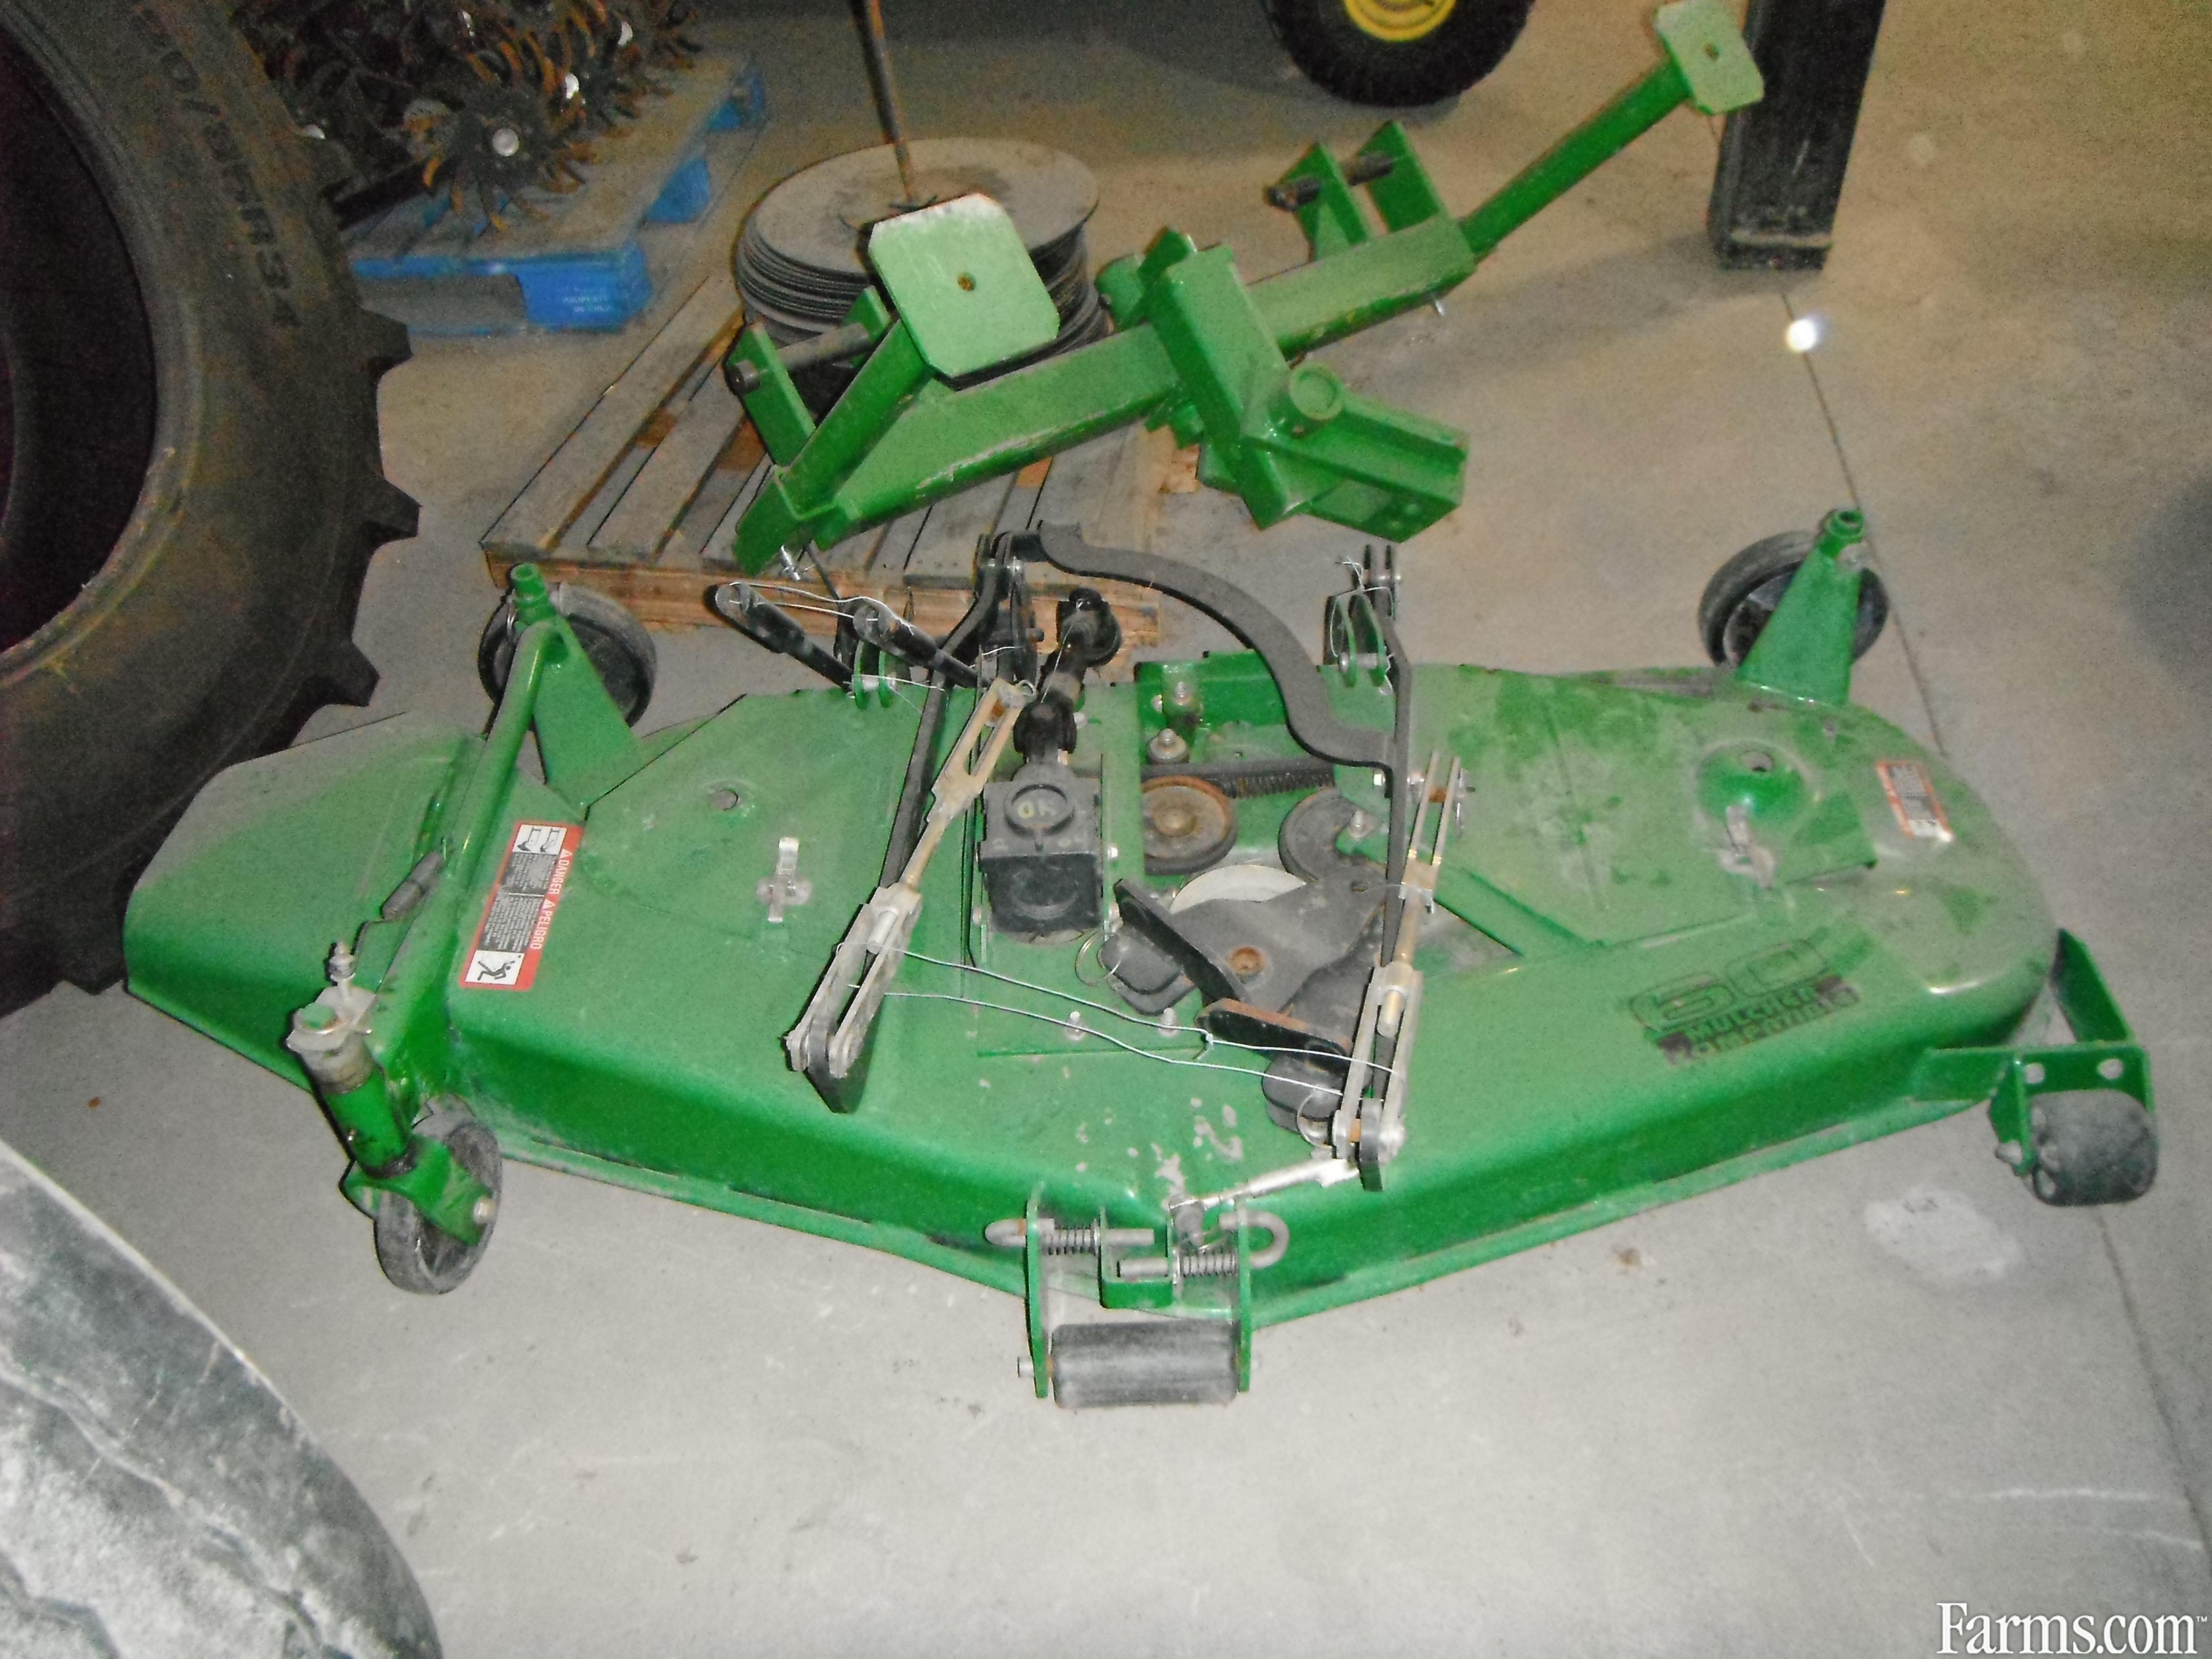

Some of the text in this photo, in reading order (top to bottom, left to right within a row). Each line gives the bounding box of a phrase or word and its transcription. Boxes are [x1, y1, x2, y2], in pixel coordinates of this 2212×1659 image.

[1017, 799, 1056, 818] OK
[530, 860, 570, 950] DANGER PELIGRO
